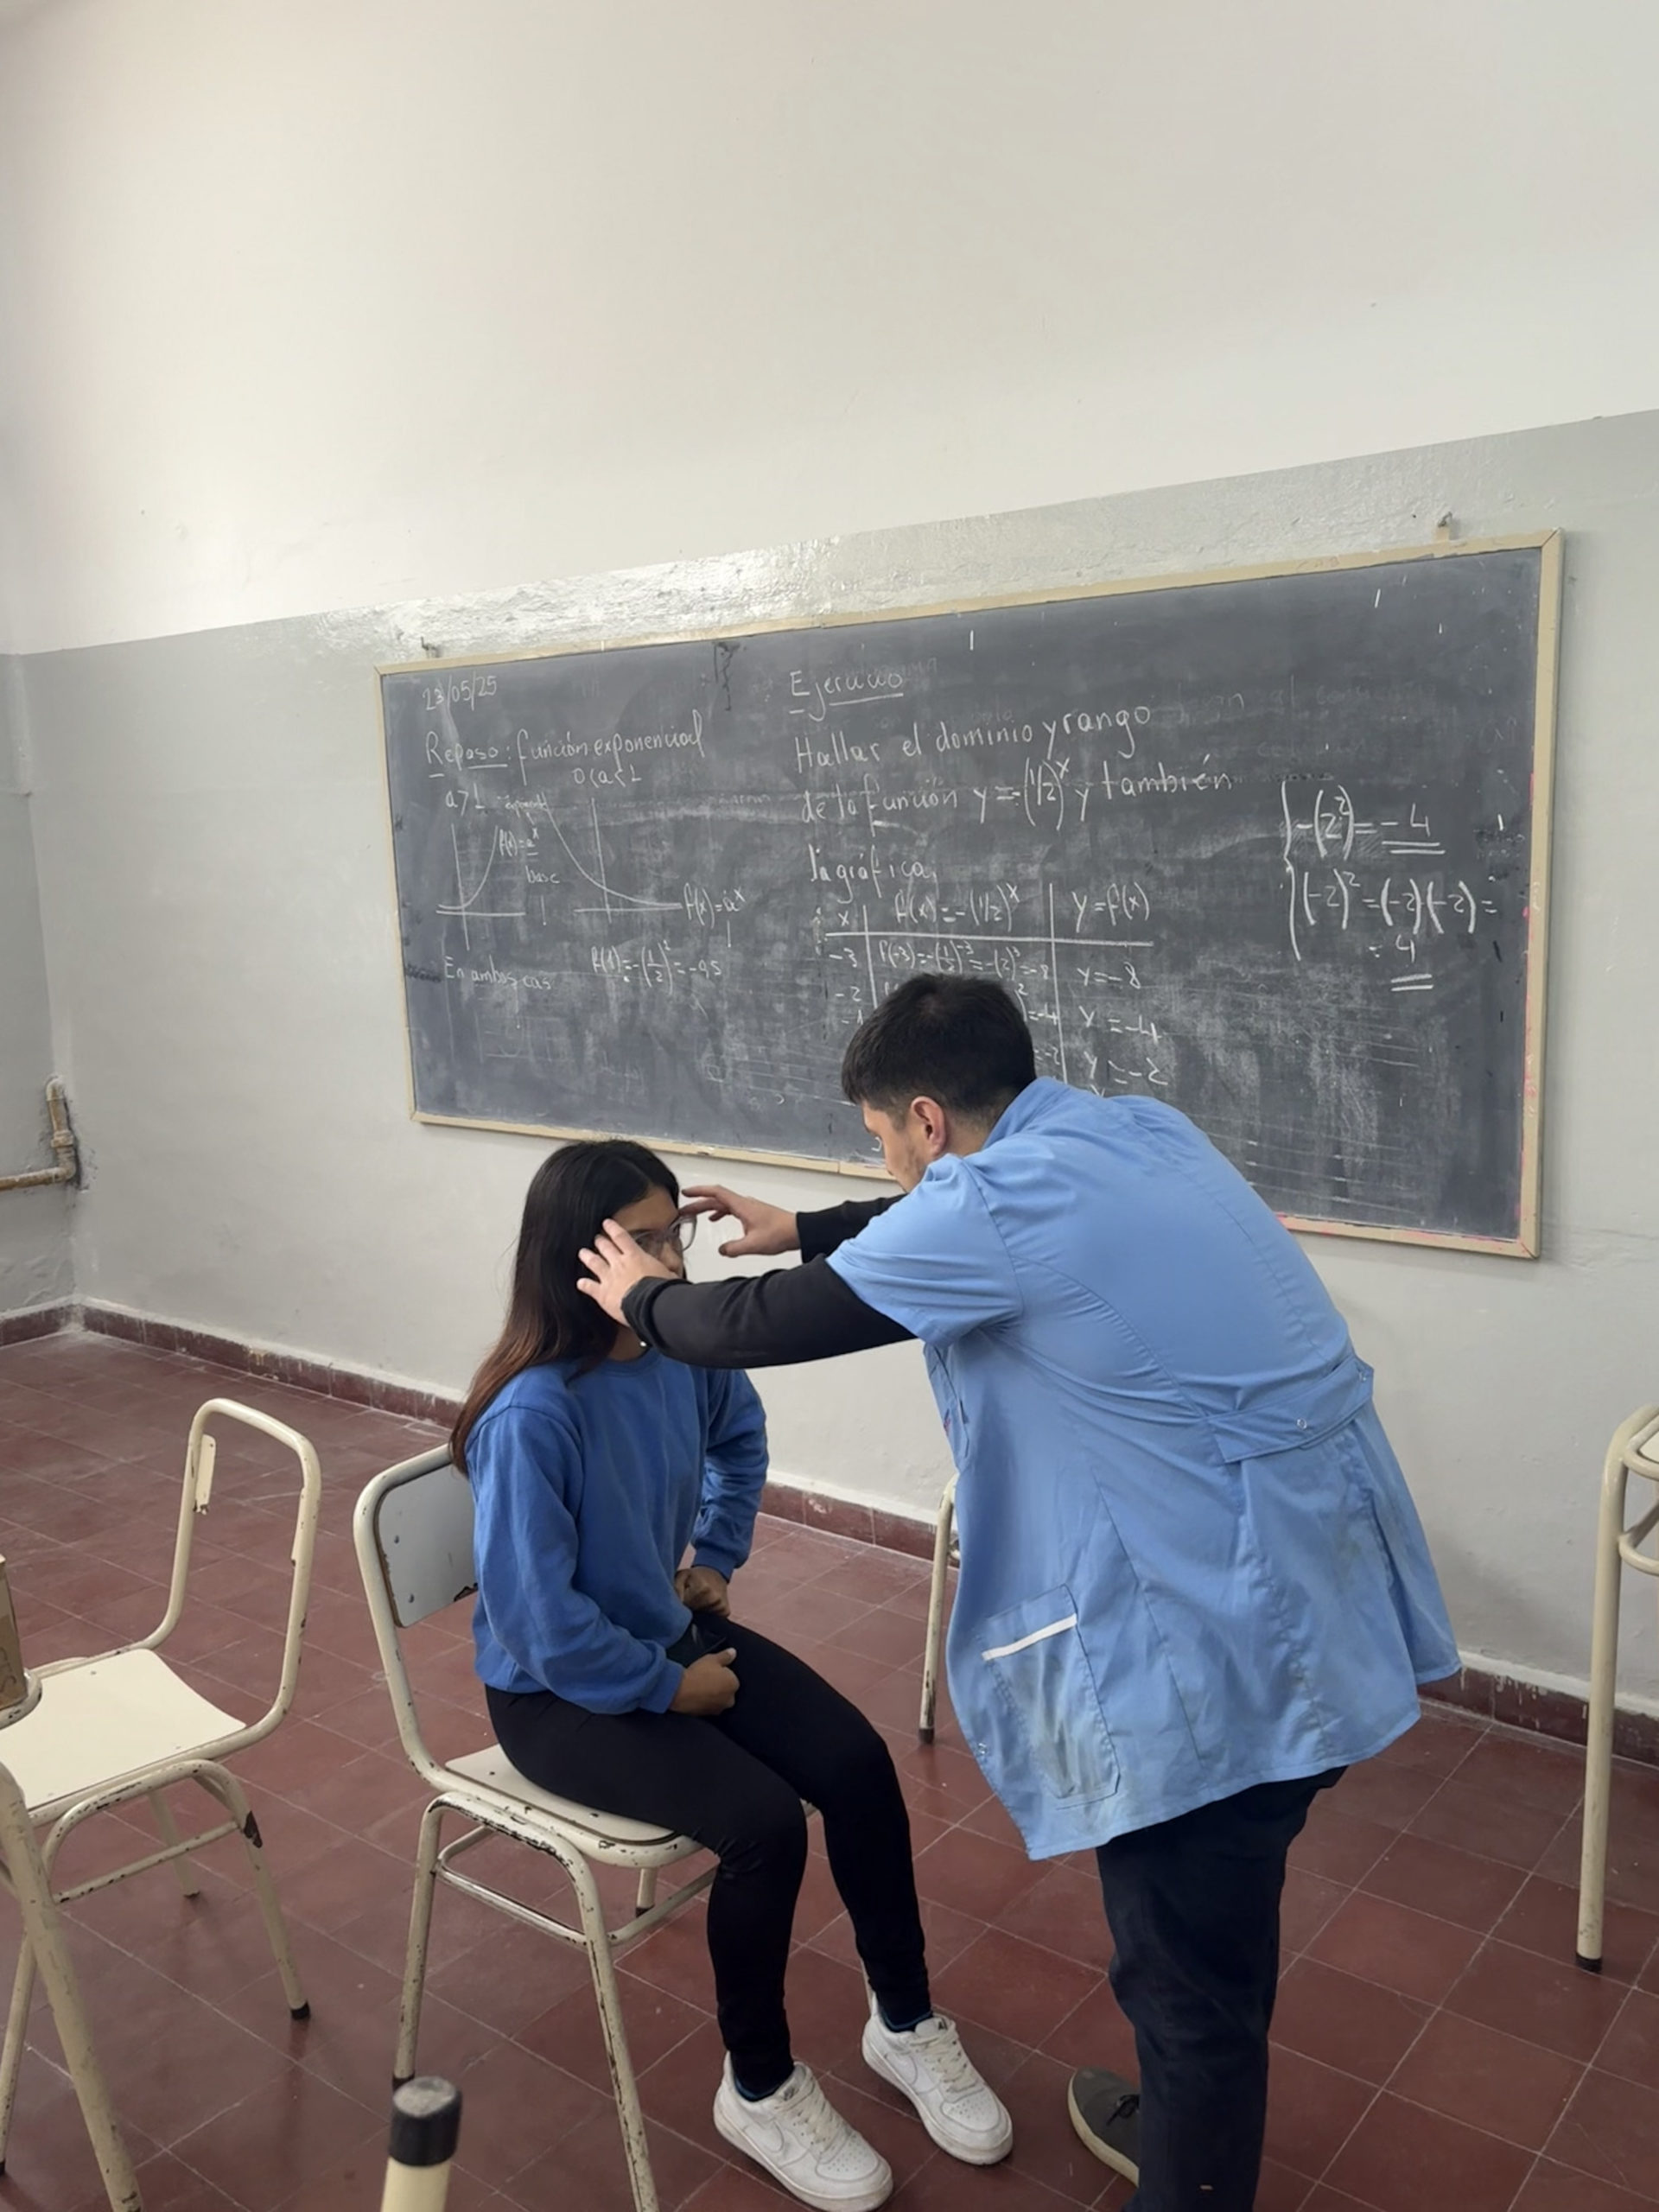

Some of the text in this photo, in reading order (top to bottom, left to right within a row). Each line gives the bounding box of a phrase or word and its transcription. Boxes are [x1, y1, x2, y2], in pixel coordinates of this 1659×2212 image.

[423, 674, 497, 711] 23/05/25
[426, 731, 511, 772] Repaso:
[795, 730, 880, 774] Hallar
[903, 721, 922, 757] el
[936, 721, 1033, 752] dominio
[1074, 787, 1090, 822] y
[1101, 753, 1233, 800] también
[525, 865, 560, 884] base
[444, 955, 465, 979] En
